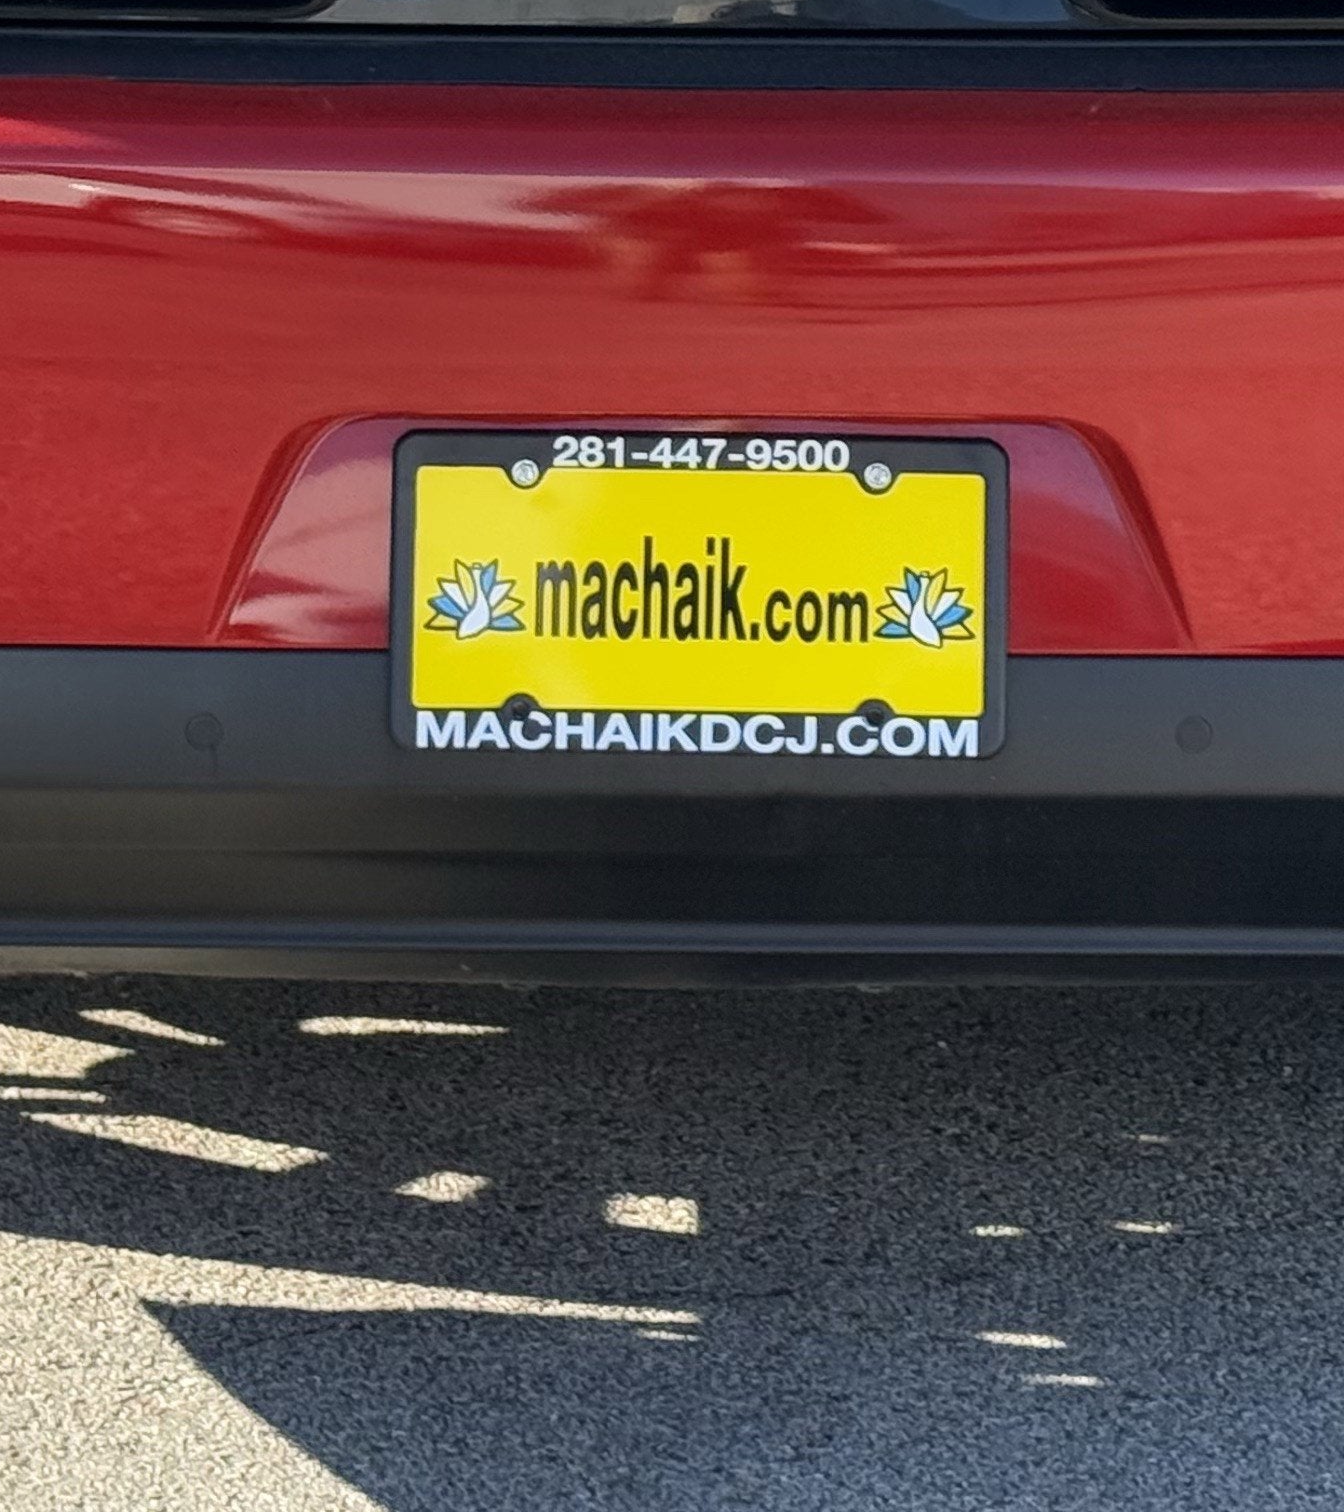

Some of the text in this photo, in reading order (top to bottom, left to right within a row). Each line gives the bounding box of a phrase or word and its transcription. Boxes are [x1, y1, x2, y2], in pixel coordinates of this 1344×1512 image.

[552, 435, 850, 472] 281-447-9500
[534, 535, 869, 643] machaik.com
[414, 709, 980, 758] MACHAIKDCJ.COM
